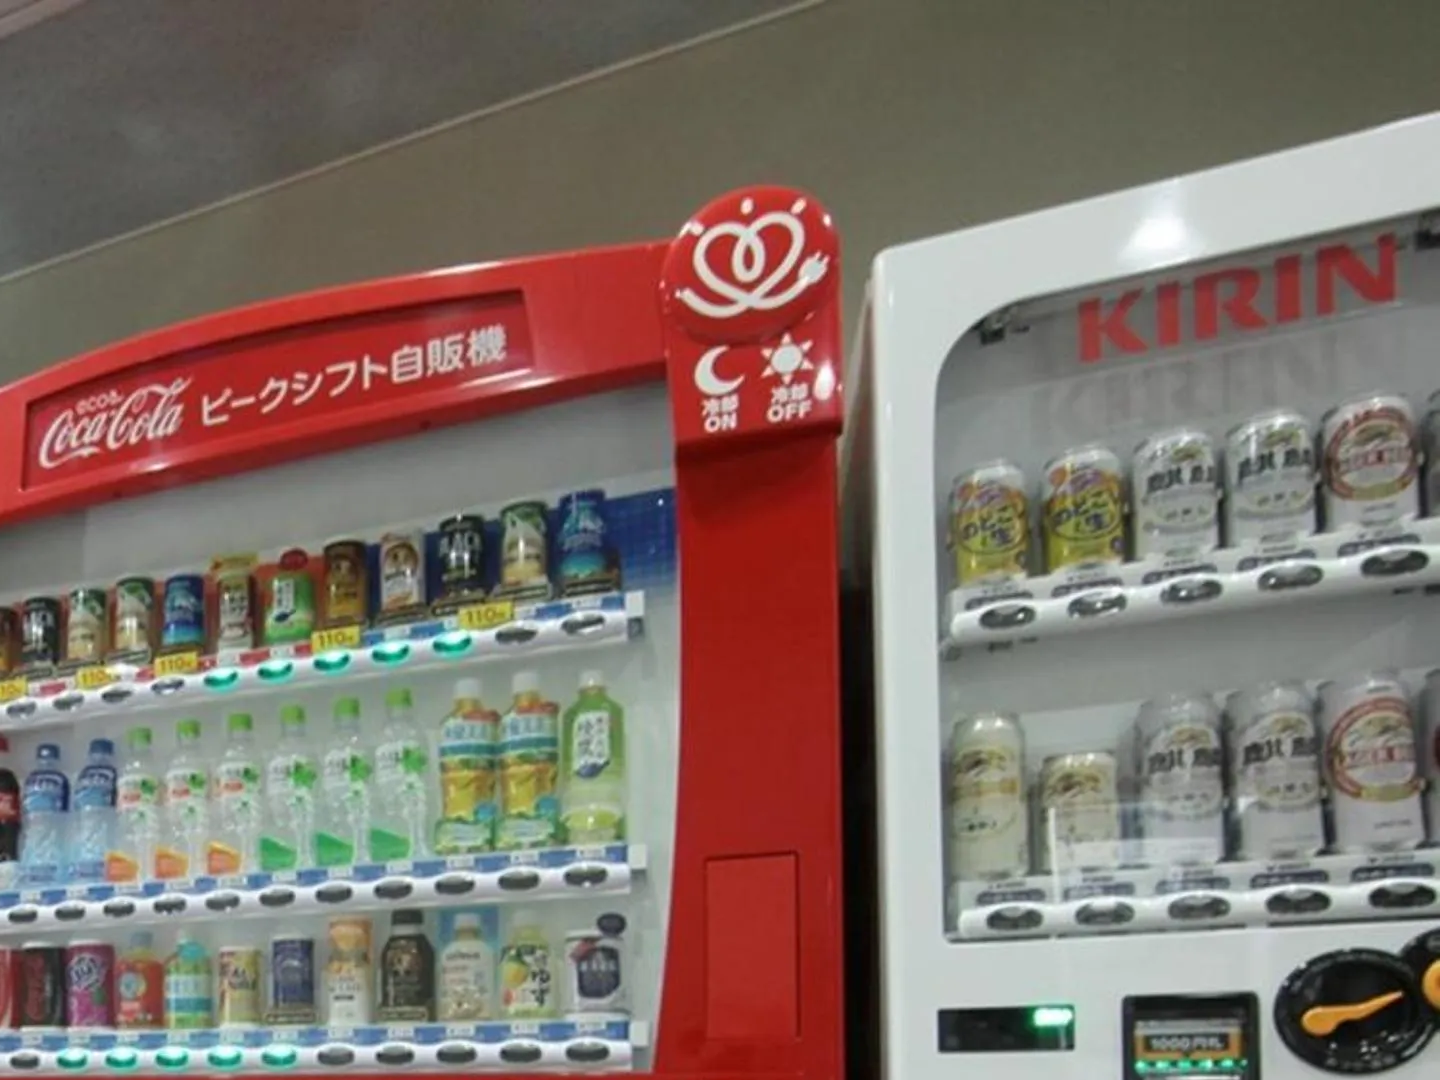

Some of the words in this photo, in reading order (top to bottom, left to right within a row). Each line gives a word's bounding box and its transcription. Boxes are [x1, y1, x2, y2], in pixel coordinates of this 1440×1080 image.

[1076, 233, 1397, 364] KIRIN
[201, 323, 507, 426] ピークシフト自販機
[767, 400, 812, 422] OFF
[38, 375, 193, 468] Coca-Cola
[704, 412, 737, 432] ON
